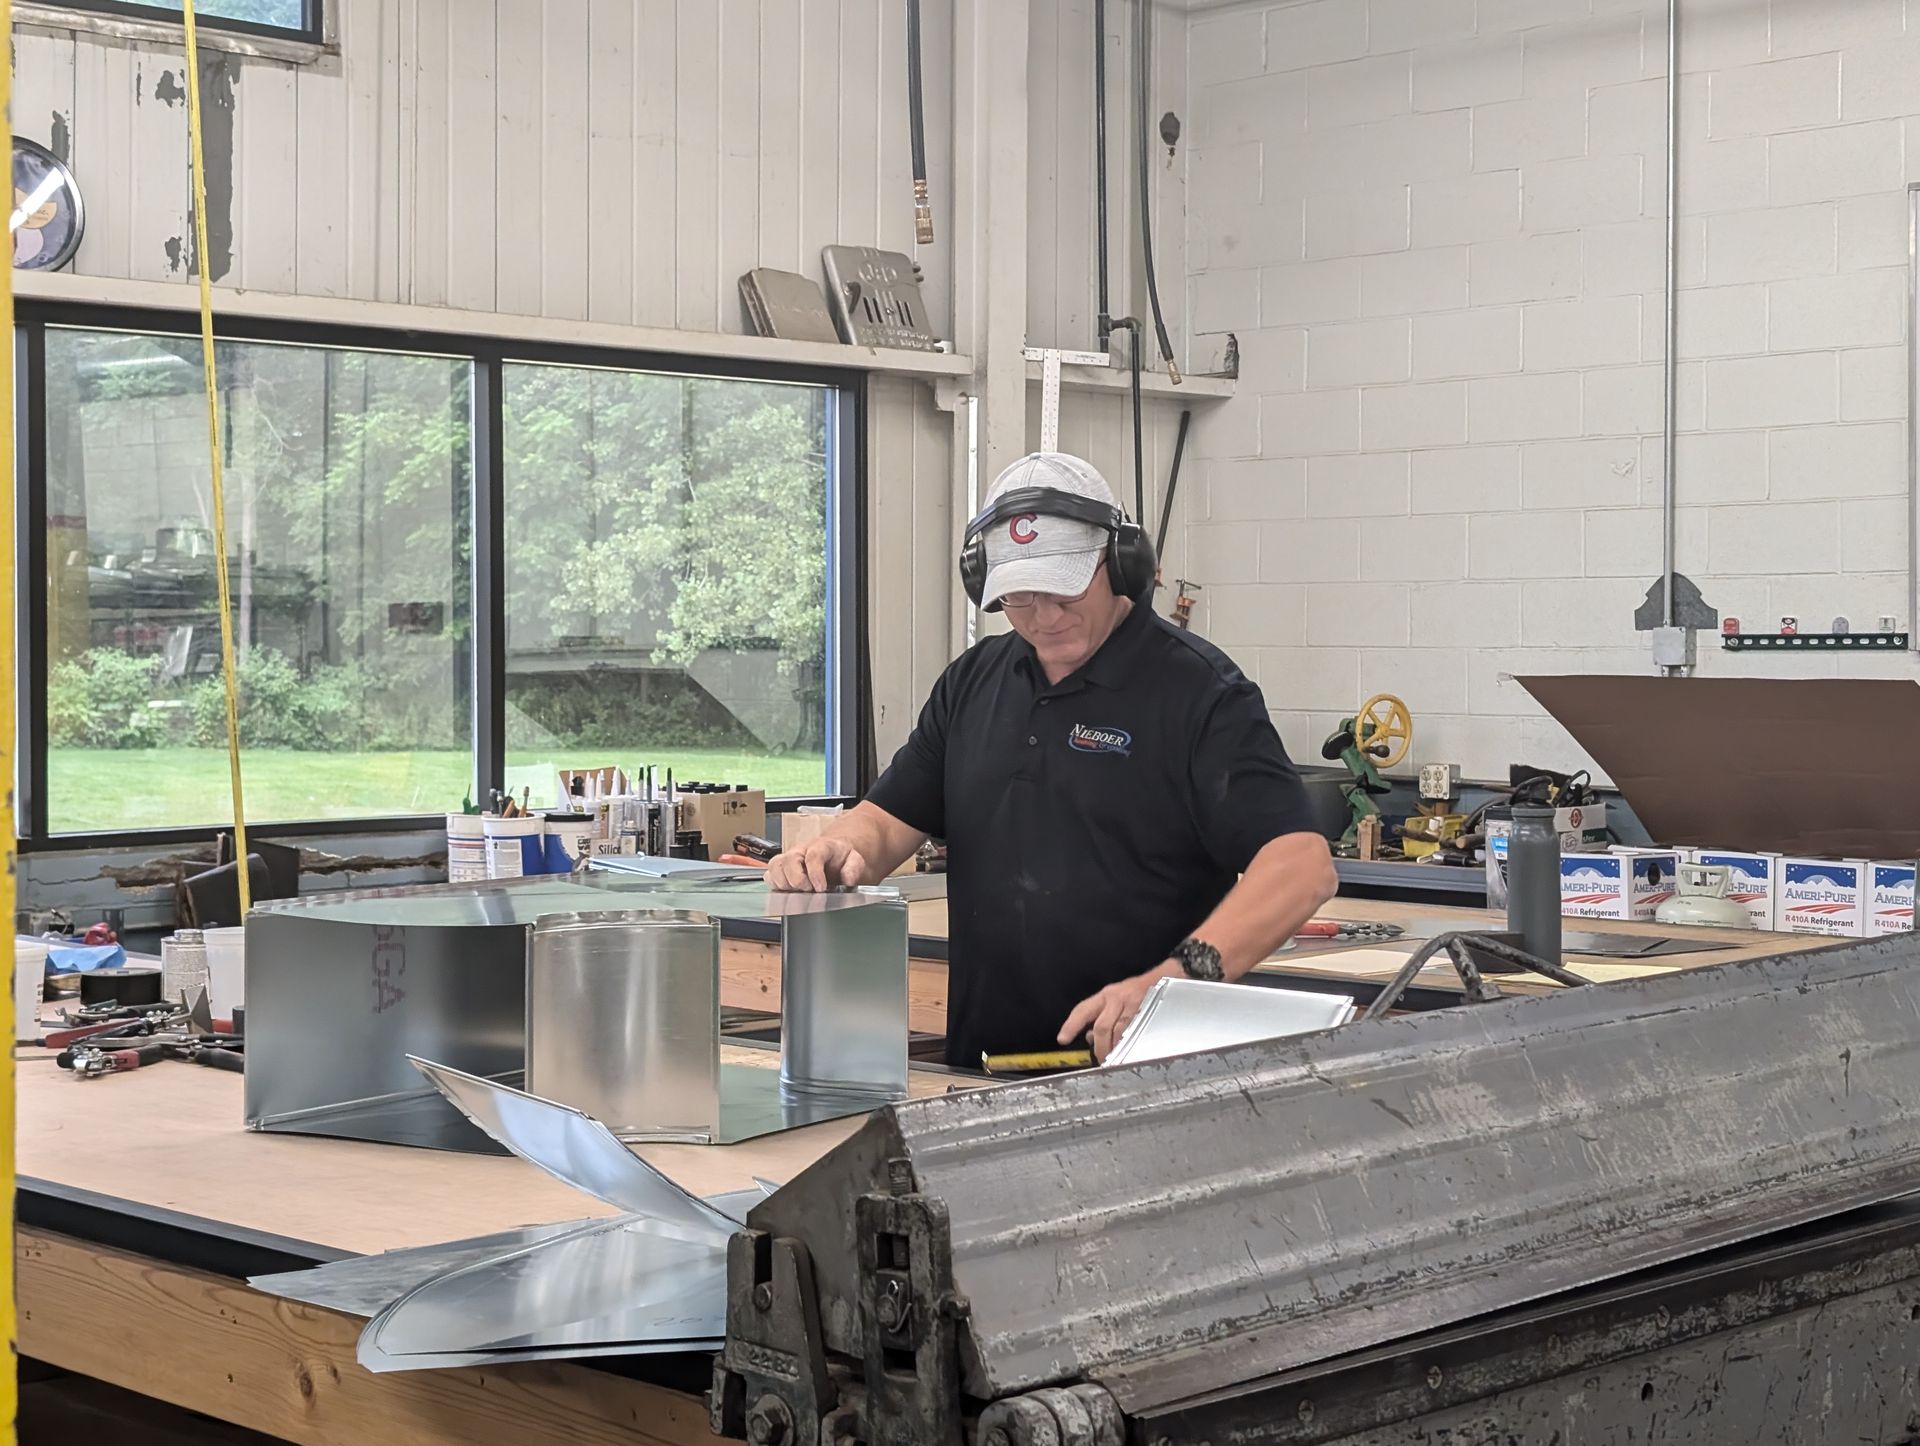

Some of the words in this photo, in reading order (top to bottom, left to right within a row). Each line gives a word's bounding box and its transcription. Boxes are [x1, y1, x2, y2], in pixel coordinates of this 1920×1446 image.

[1009, 512, 1039, 545] C
[1069, 723, 1124, 746] NIEBOER
[1785, 888, 1856, 903] AMERI-PURE
[1580, 908, 1620, 918] Refrigerant
[1810, 917, 1854, 927] Refrigerant
